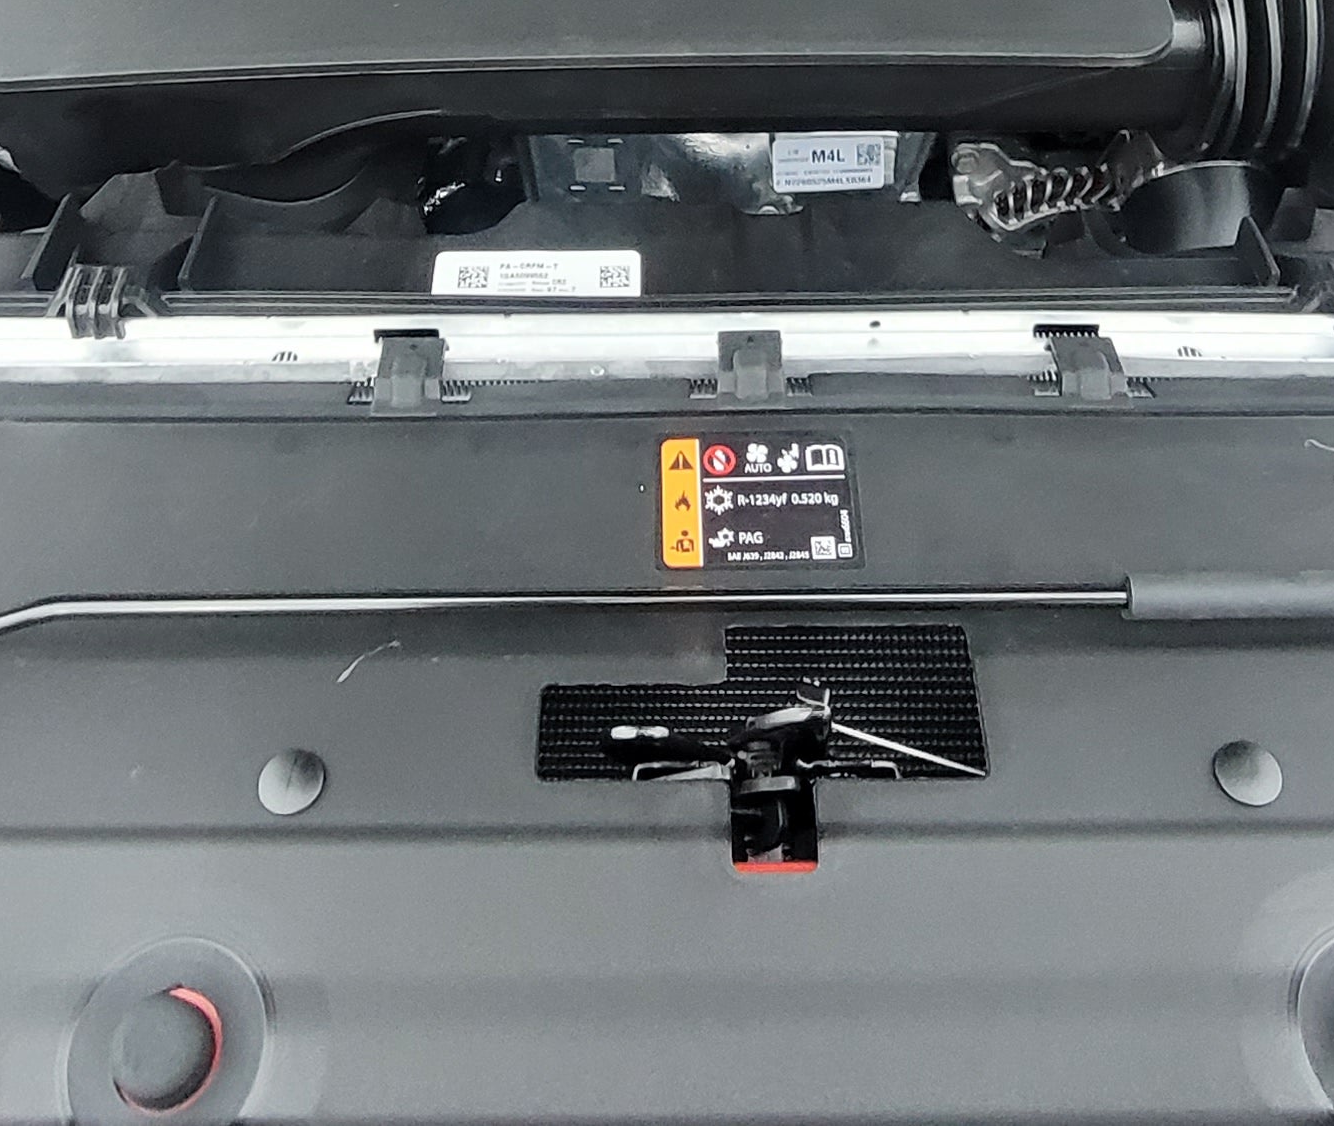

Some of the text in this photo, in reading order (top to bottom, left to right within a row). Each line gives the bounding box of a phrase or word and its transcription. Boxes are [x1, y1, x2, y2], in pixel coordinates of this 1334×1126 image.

[811, 149, 845, 164] M4L
[744, 462, 773, 474] AUTO
[737, 491, 839, 508] R-1234yf 0.520 kg
[738, 532, 764, 545] PAG
